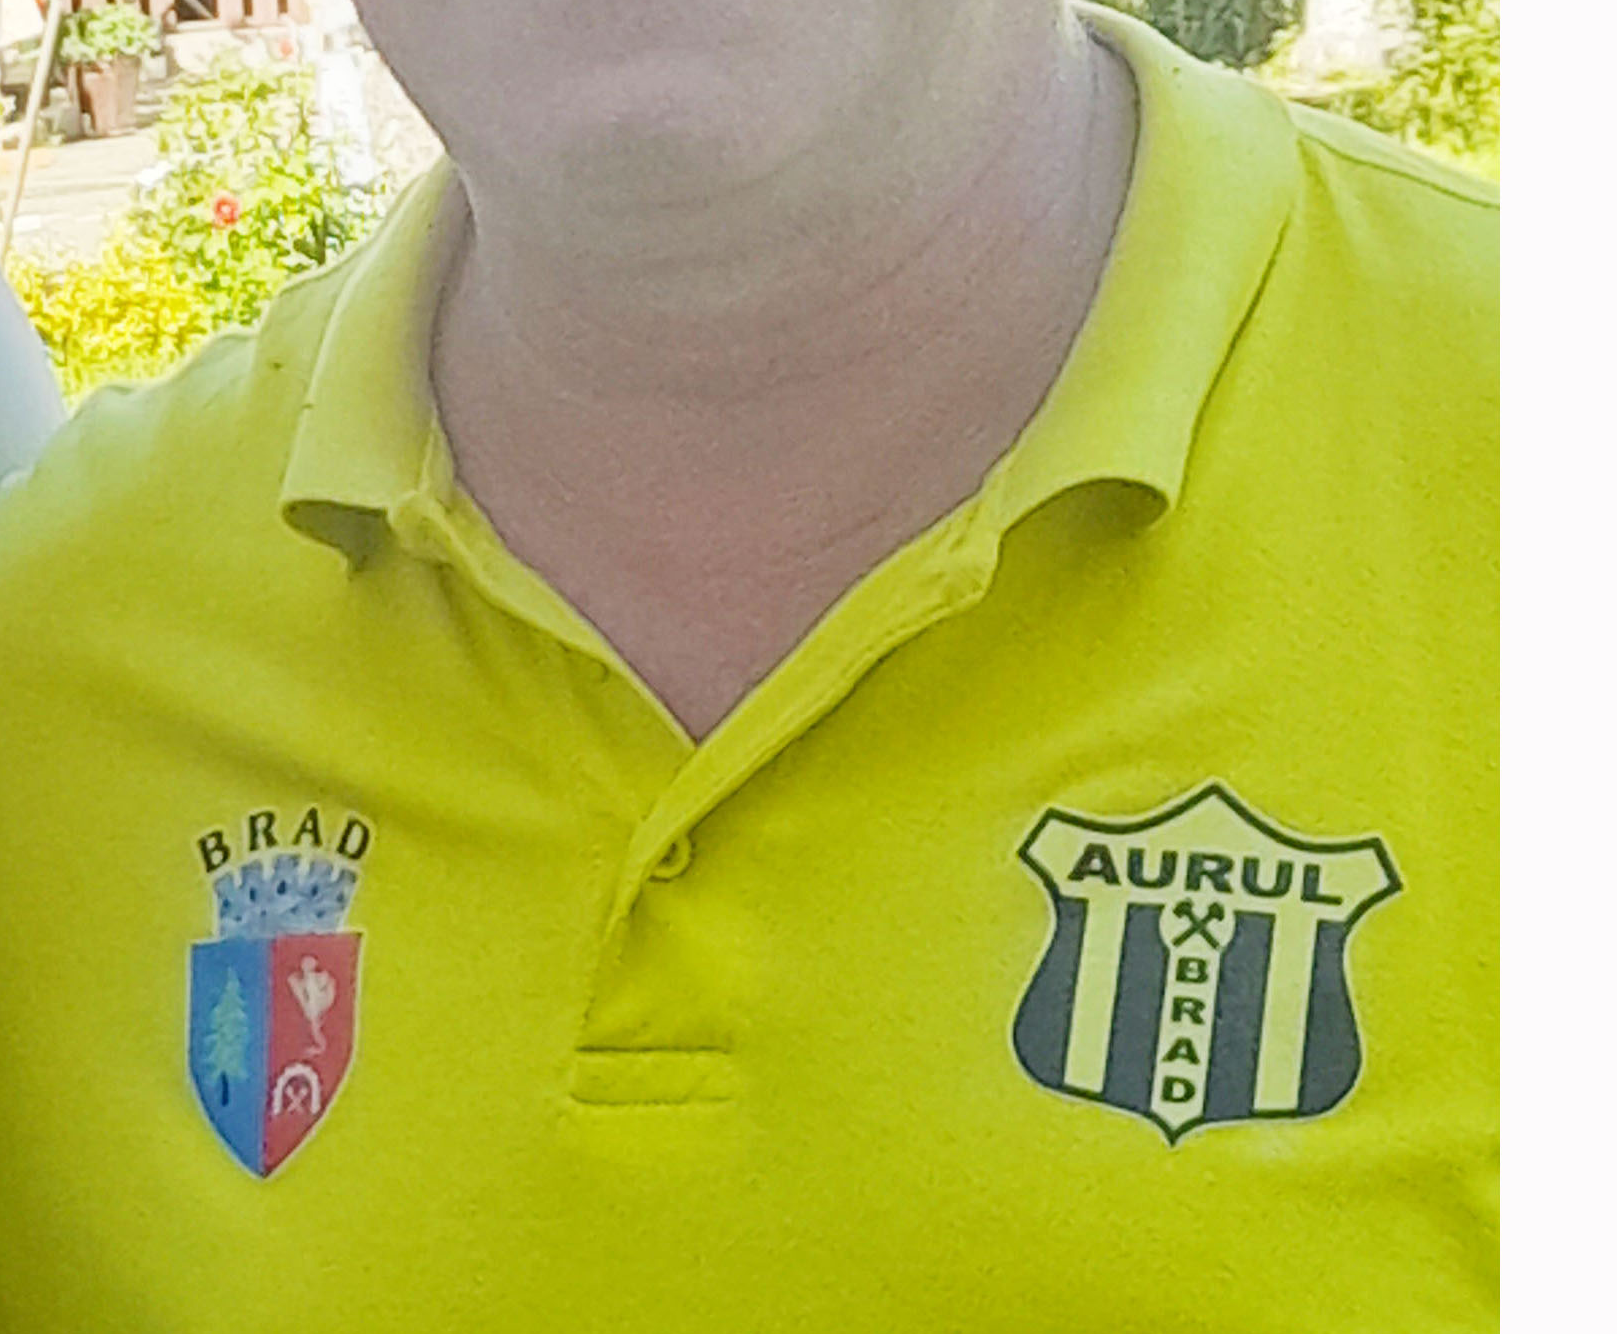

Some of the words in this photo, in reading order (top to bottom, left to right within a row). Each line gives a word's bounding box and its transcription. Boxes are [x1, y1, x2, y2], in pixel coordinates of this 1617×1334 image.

[197, 807, 370, 872] BRAD
[1068, 843, 1343, 906] AURUL
[1161, 957, 1209, 1103] BRAD
